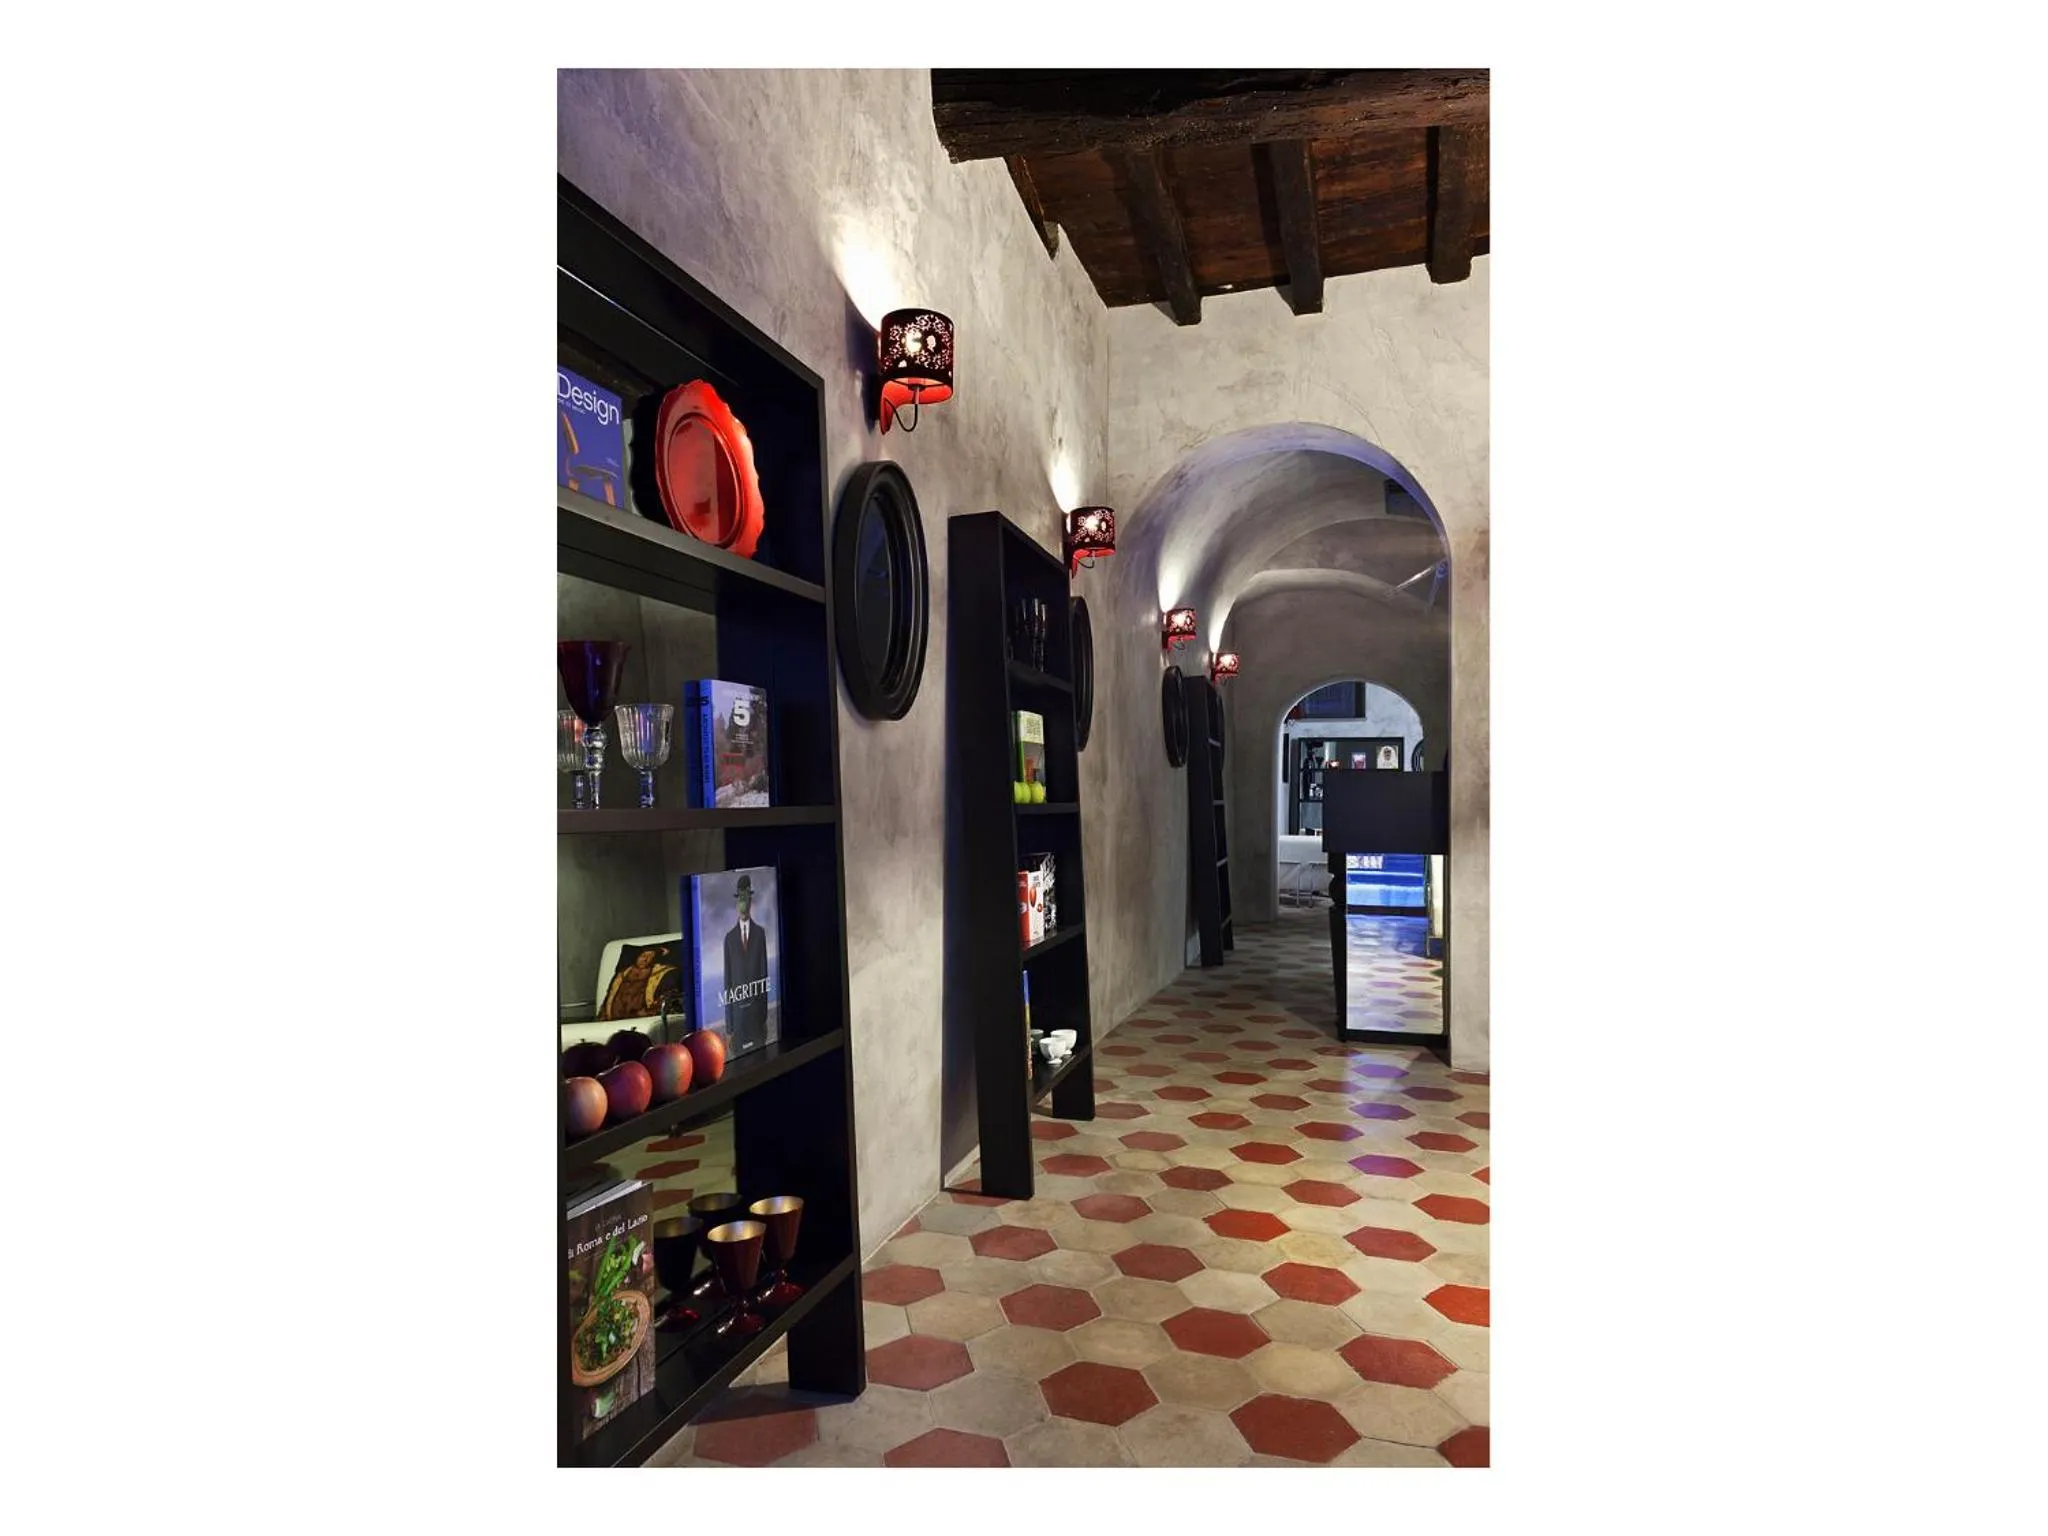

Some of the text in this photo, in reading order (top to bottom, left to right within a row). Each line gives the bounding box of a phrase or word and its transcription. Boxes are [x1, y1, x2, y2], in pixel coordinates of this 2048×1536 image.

[557, 372, 620, 425] Design
[733, 700, 750, 727] 5
[718, 976, 771, 1008] MAGRITTE
[576, 1237, 602, 1255] Roma
[612, 1222, 625, 1237] del
